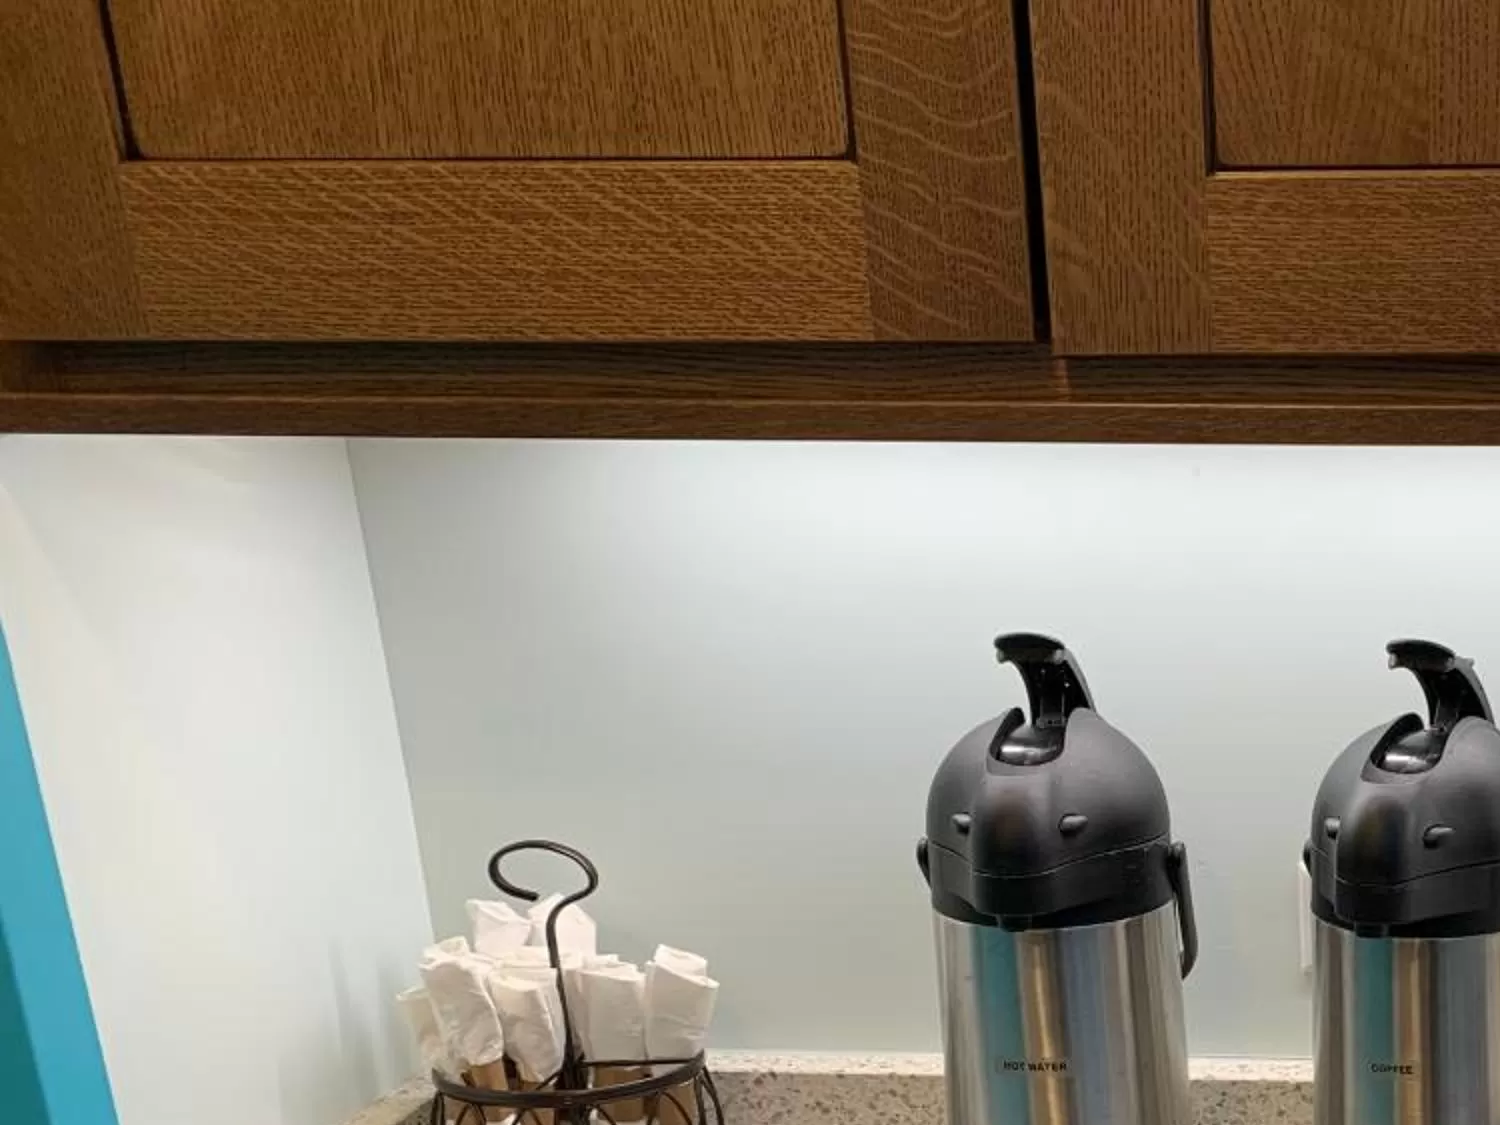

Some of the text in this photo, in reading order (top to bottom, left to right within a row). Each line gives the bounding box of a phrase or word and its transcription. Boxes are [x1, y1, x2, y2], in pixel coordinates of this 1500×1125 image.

[1003, 1060, 1068, 1072] HOT WATER
[1367, 1063, 1414, 1075] COFFEE
